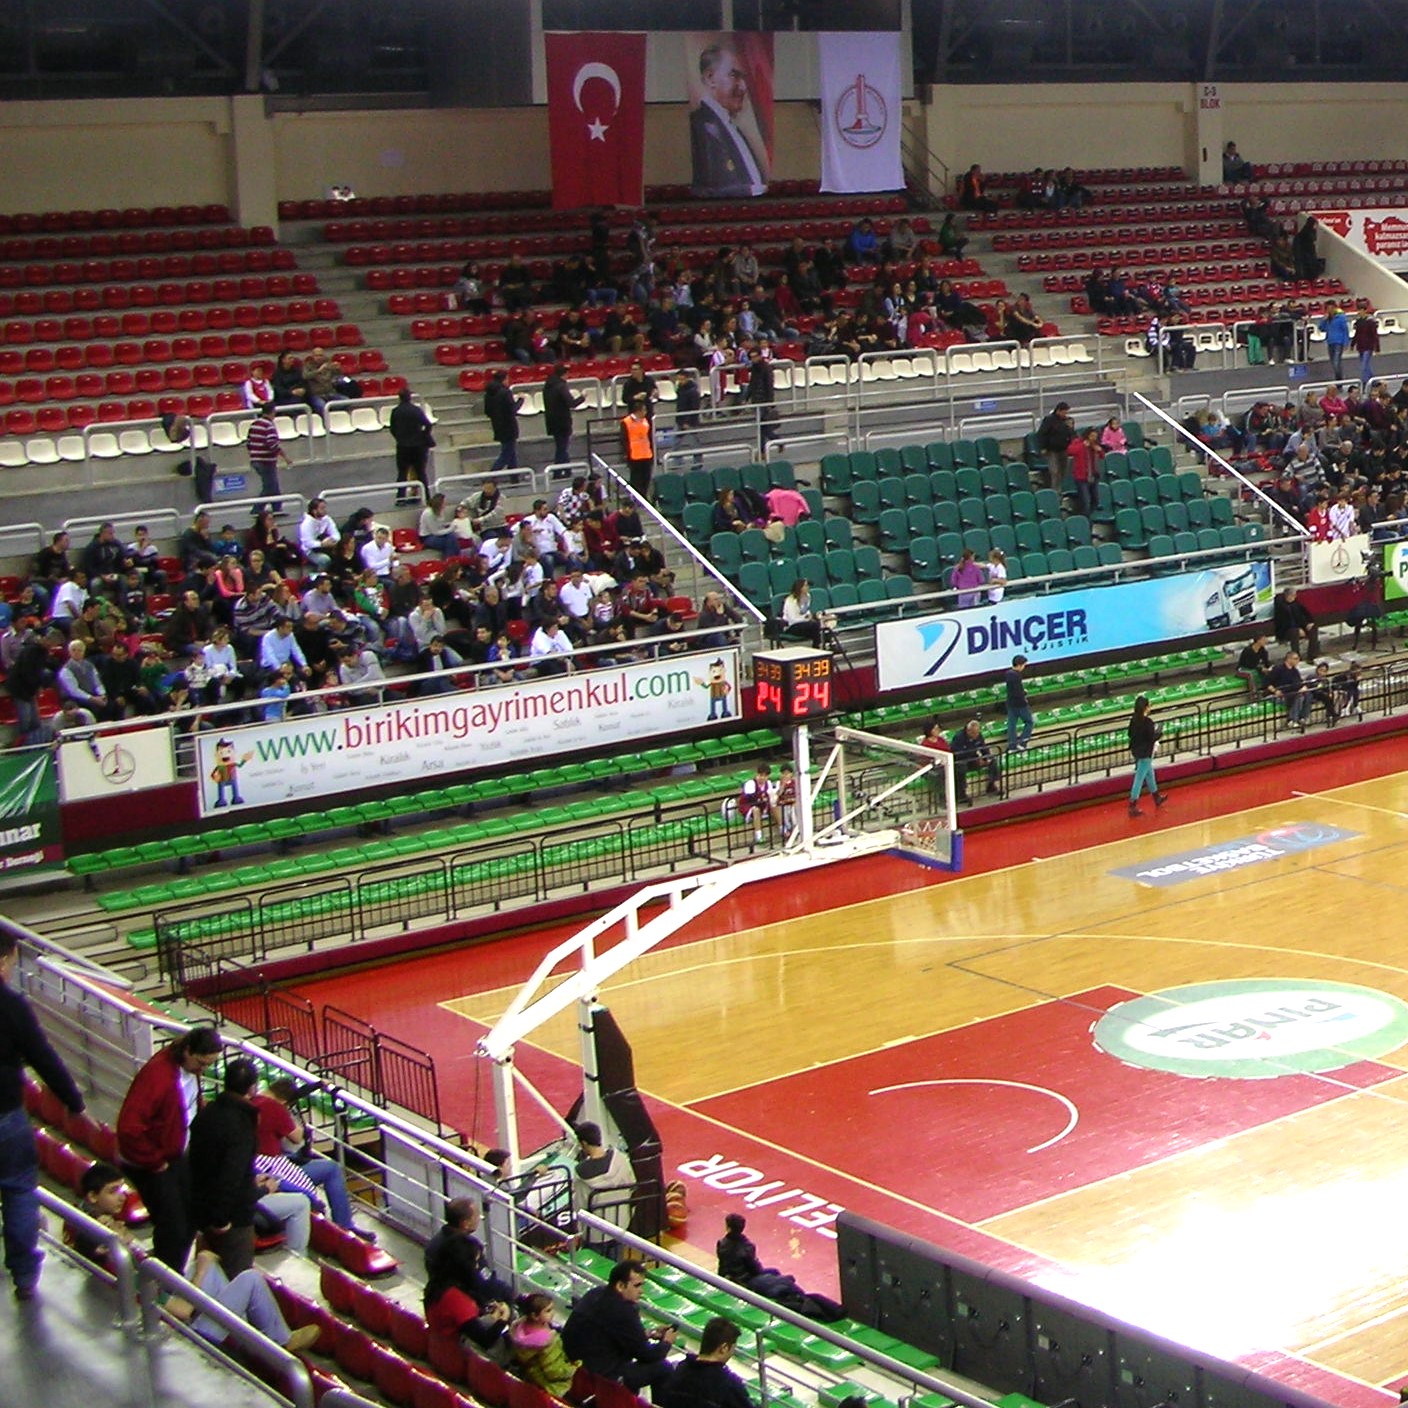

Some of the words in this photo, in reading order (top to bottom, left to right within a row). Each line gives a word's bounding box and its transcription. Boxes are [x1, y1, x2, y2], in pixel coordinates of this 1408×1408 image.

[1200, 98, 1221, 110] BLOK
[967, 607, 1088, 654] DİNÇER
[256, 669, 691, 763] www.birikimgayrimenkul.com
[757, 681, 781, 713] 24
[793, 681, 829, 715] 24
[1178, 998, 1343, 1049] PINAR
